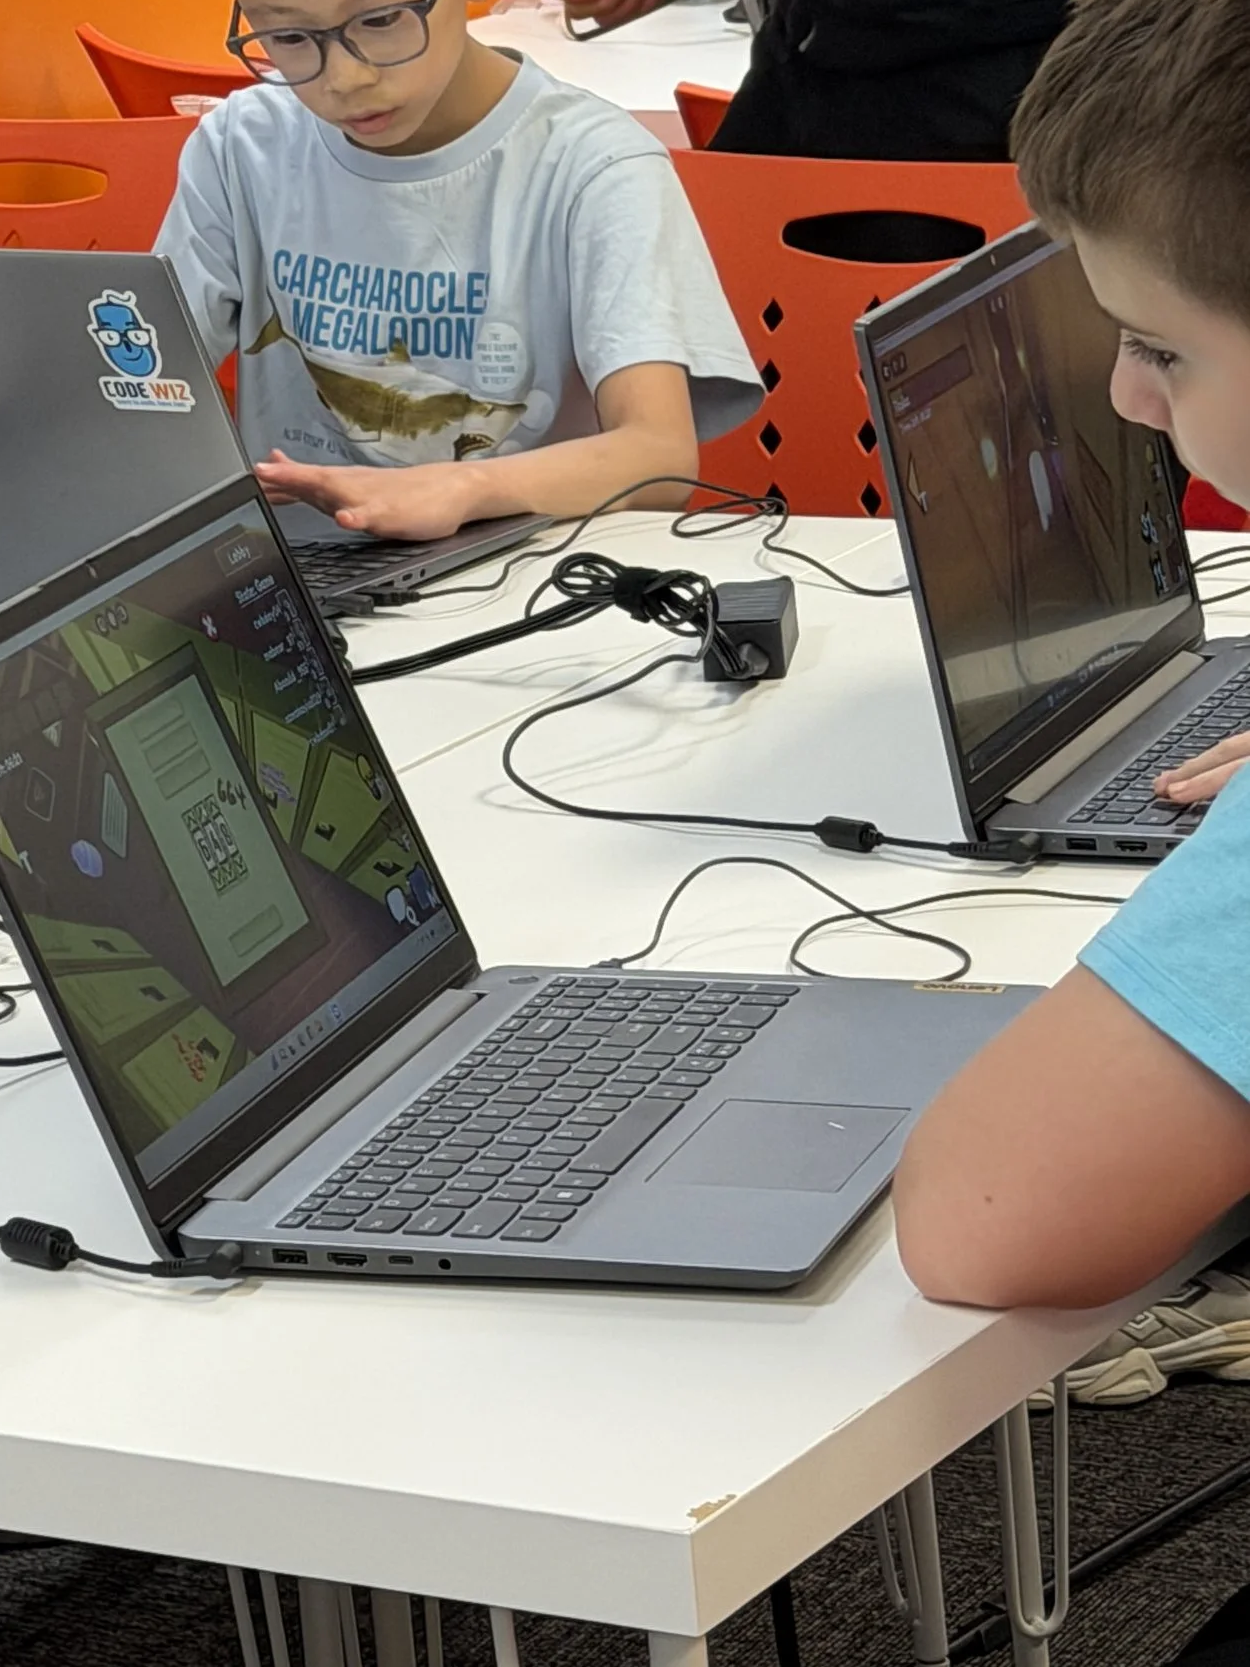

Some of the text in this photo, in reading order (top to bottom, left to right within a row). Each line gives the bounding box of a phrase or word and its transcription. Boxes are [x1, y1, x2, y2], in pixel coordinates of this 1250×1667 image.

[292, 297, 475, 361] MEGALODON
[103, 380, 191, 401] CODE WIZ
